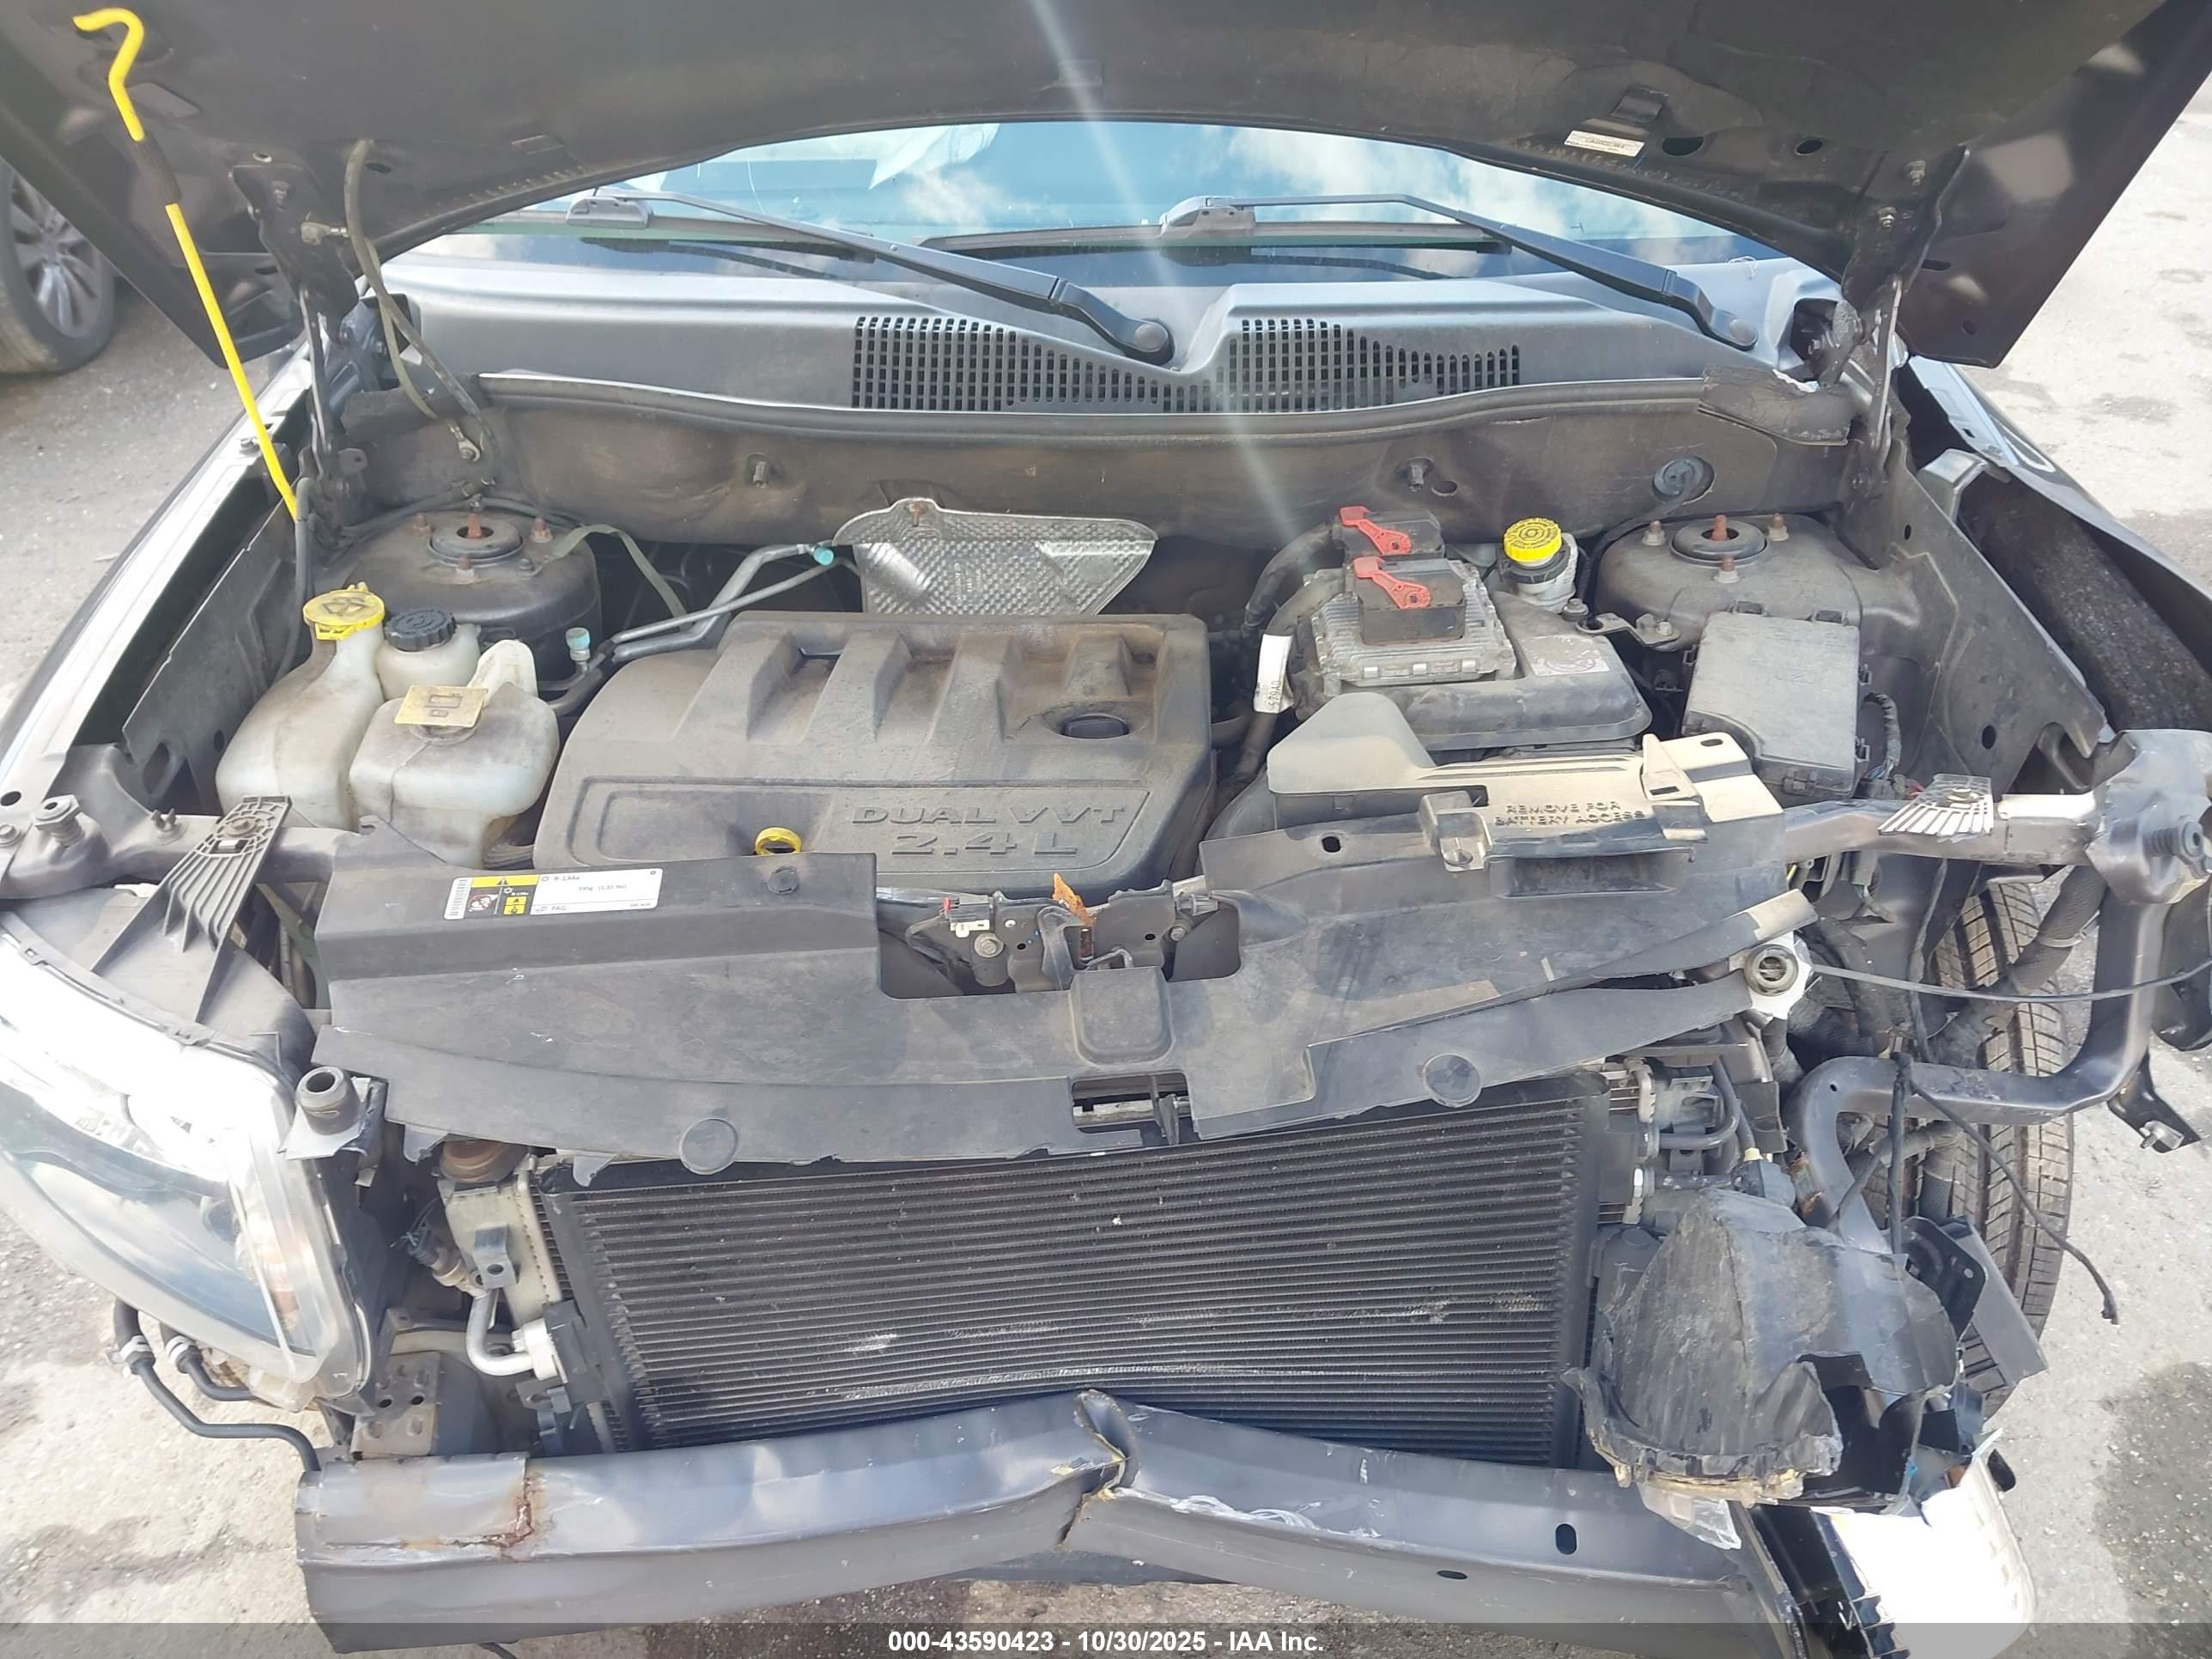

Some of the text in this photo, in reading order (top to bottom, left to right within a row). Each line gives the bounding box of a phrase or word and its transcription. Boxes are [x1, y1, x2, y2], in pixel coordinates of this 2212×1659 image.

[852, 806, 1126, 824] DUAL VVT
[1505, 801, 1621, 815] REMOVE FOR
[1494, 811, 1645, 826] BATTERY ACCESS
